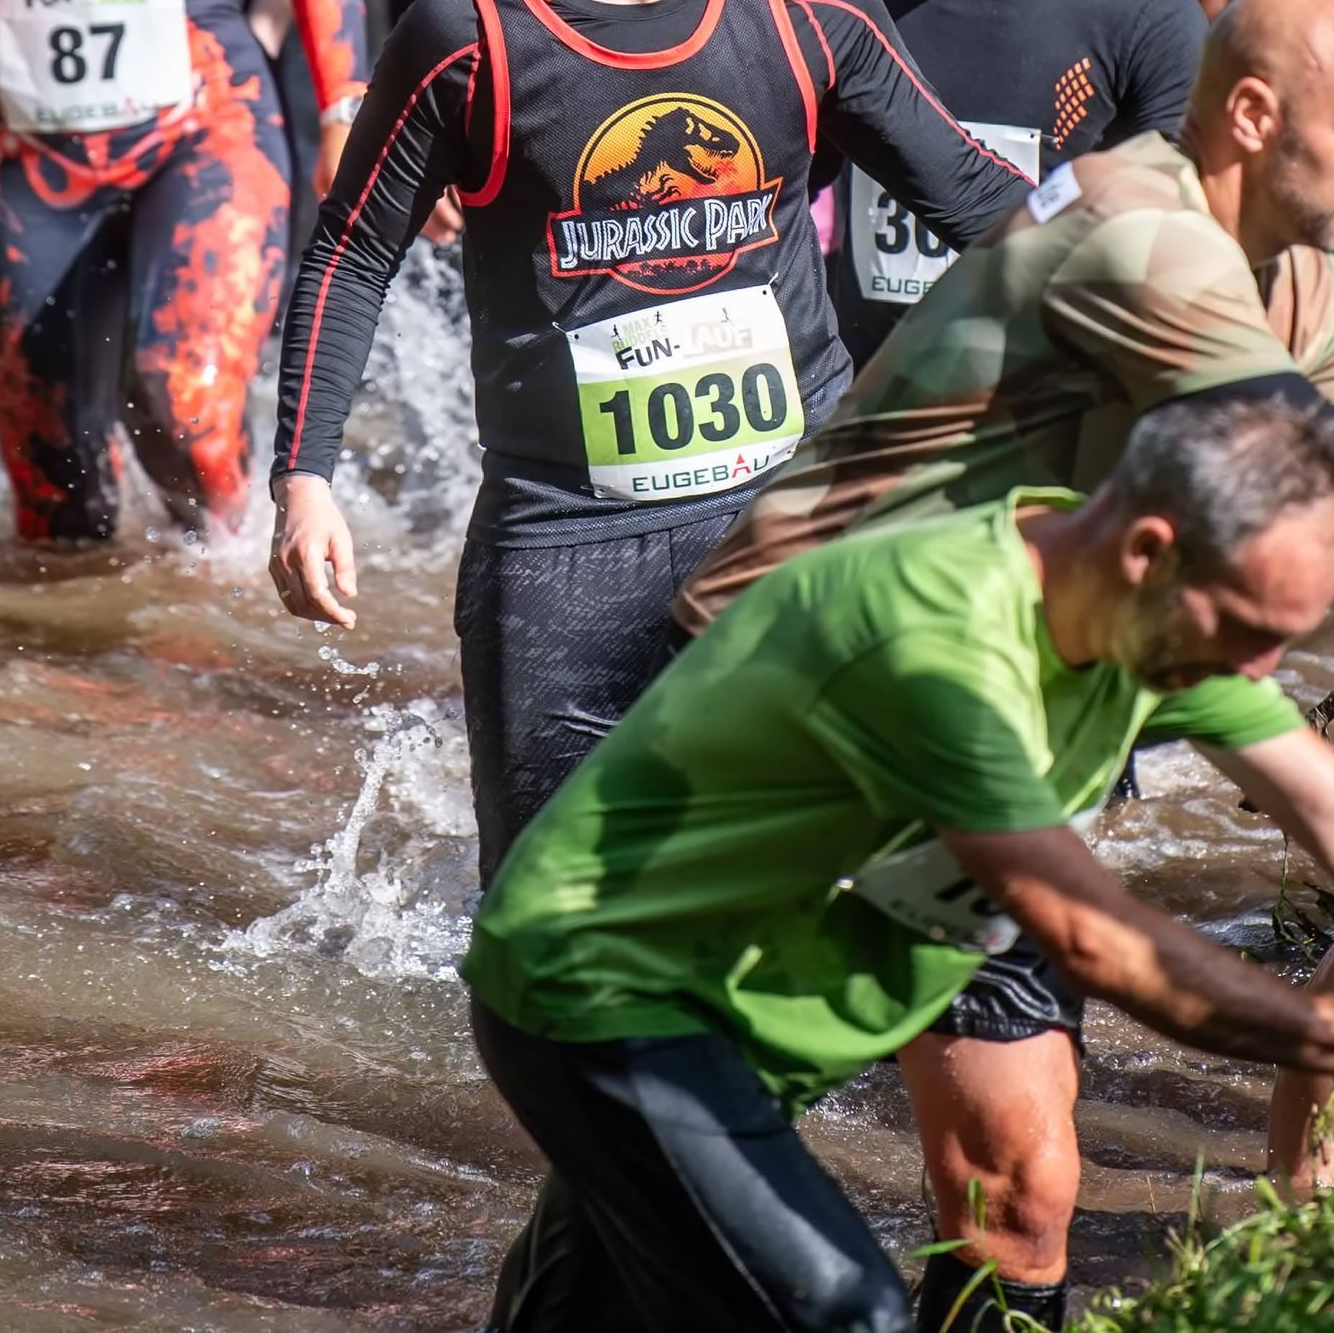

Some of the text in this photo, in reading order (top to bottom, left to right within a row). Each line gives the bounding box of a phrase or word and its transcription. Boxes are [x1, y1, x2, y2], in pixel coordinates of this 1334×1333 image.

[49, 21, 126, 84] 87
[560, 193, 773, 269] JURASSIC PARK
[616, 337, 681, 370] FUN-
[599, 363, 788, 455] 1030
[632, 453, 770, 493] EUGEBAU
